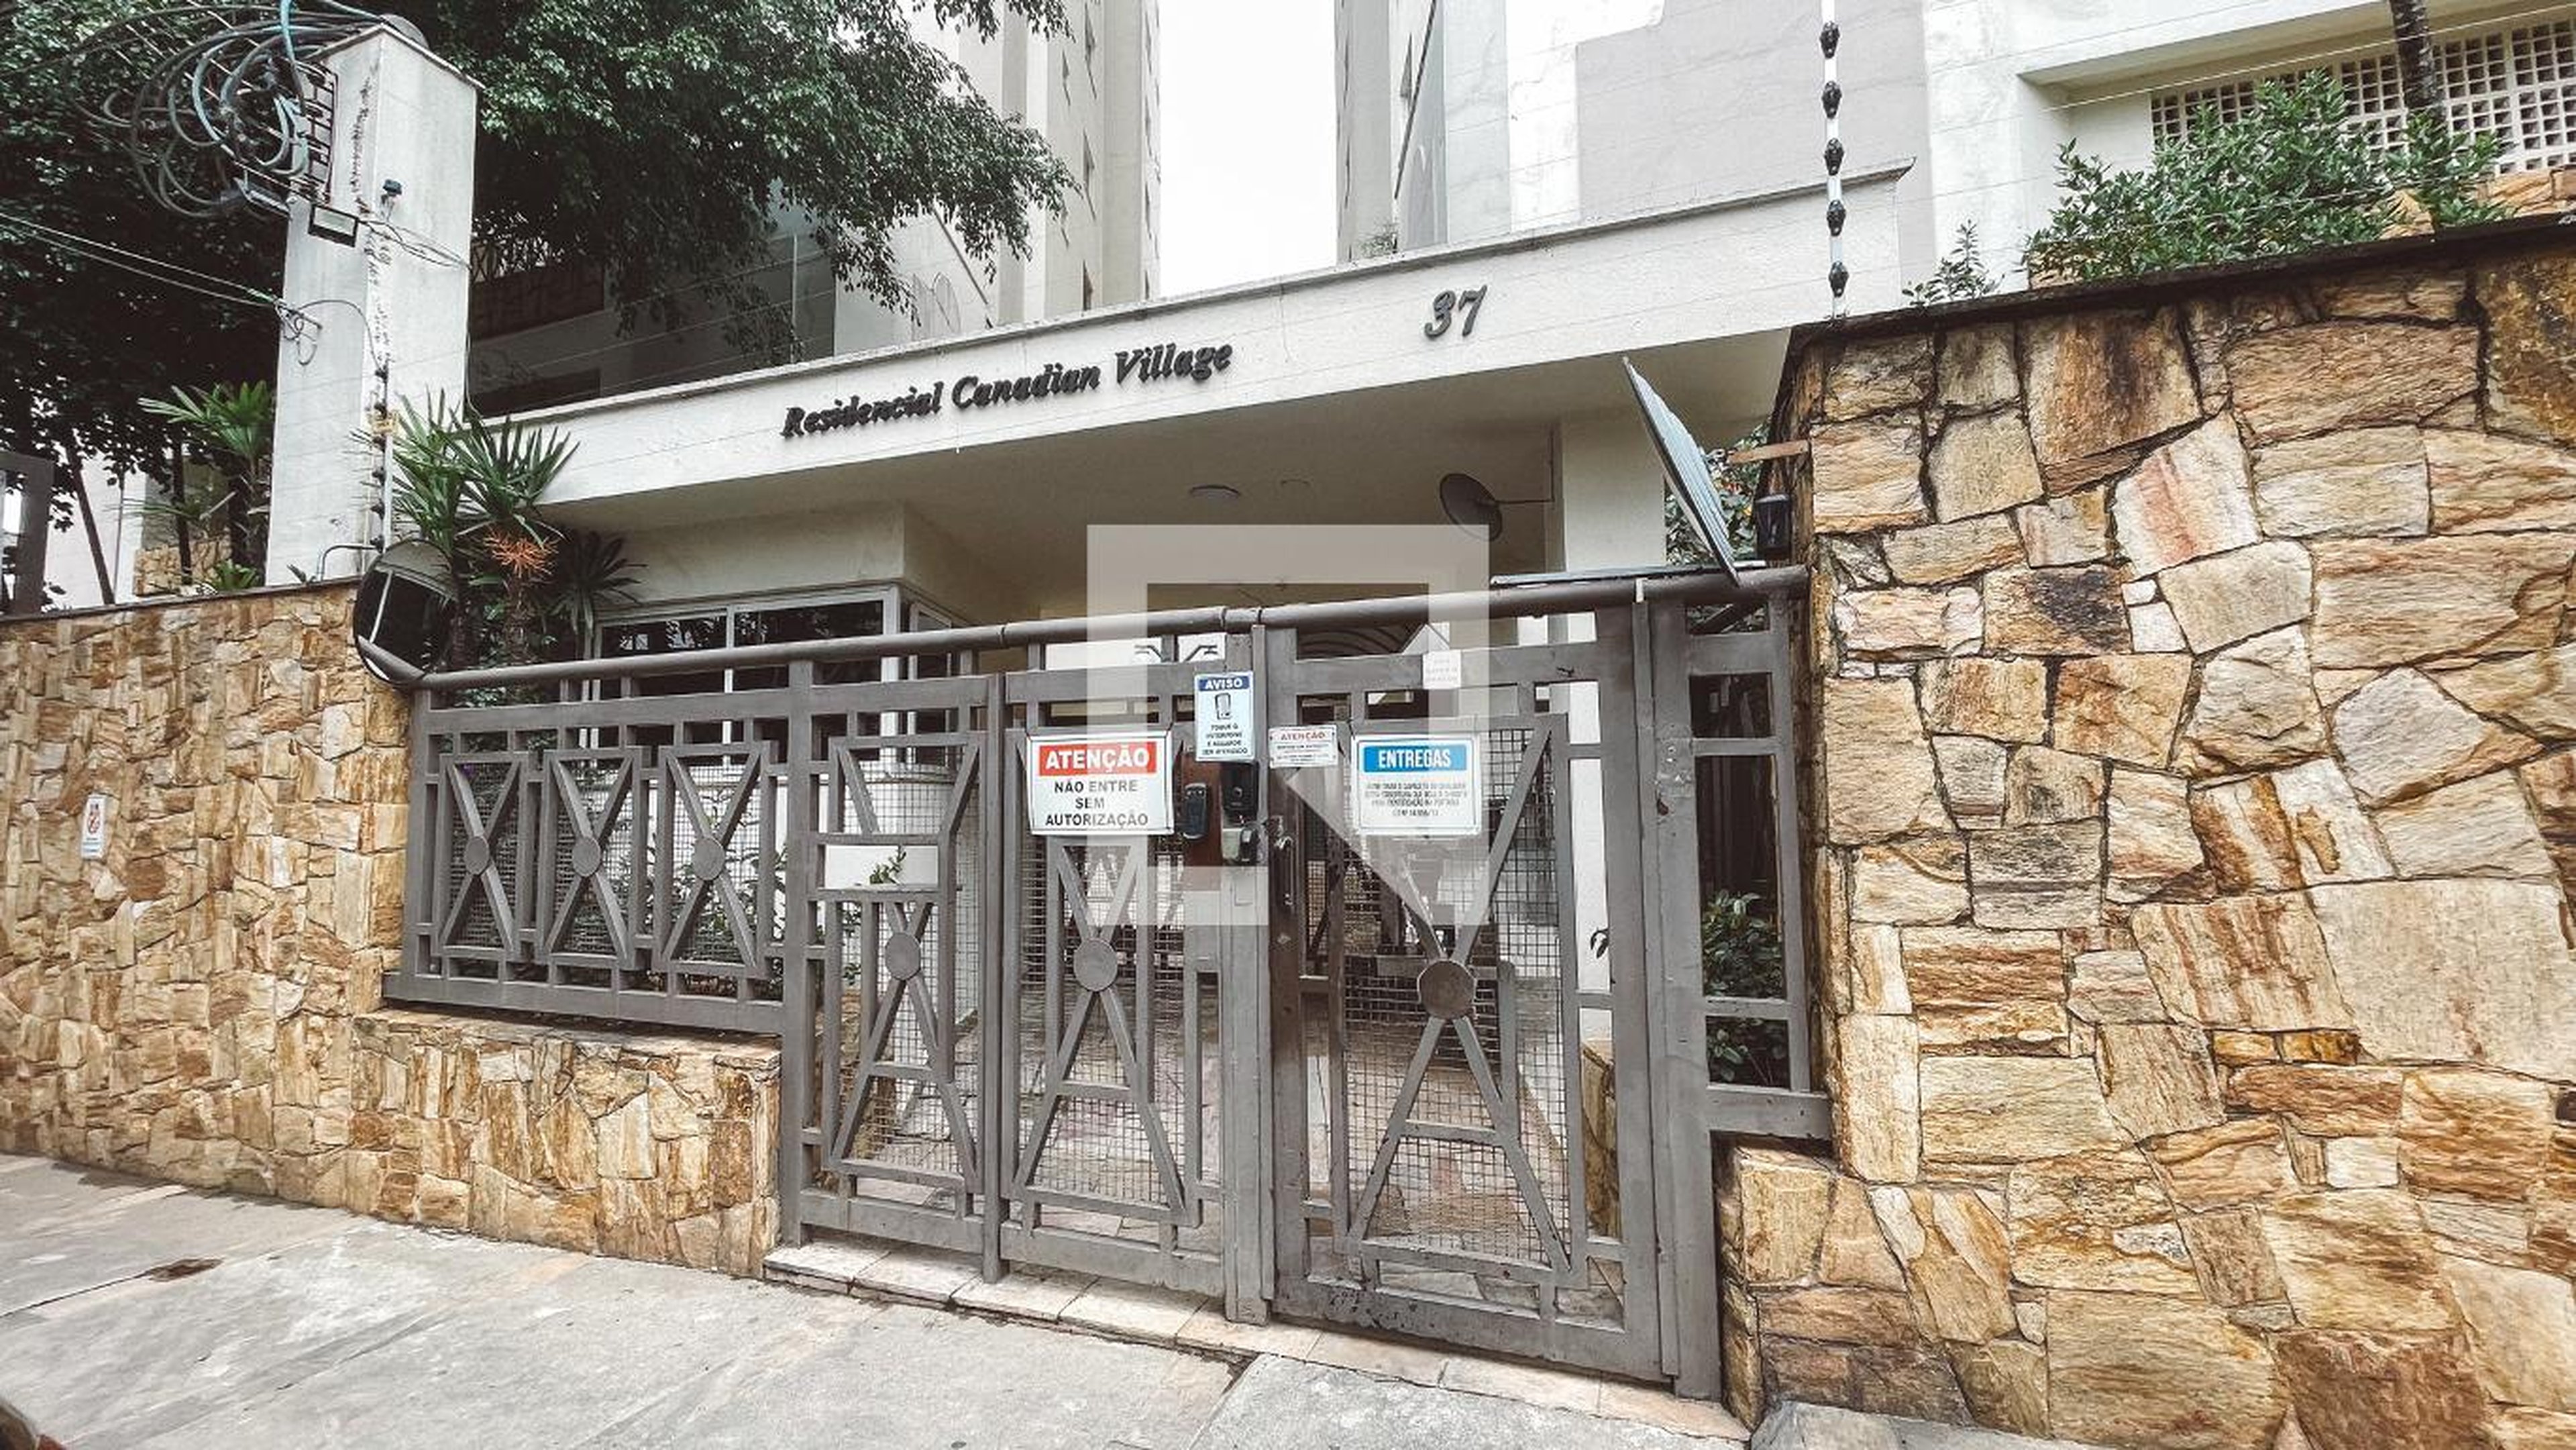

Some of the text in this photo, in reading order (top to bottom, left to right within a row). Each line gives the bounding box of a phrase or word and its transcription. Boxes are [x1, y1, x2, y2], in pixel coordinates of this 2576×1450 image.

[1424, 284, 1487, 340] 37
[780, 342, 1232, 437] Residencial Canadian Village
[1205, 677, 1242, 690] AVISO
[1045, 744, 1150, 773] ATENÇÃO
[1378, 749, 1452, 768] ENTREGAS
[1055, 778, 1138, 793] NÃO ENTRE
[1075, 797, 1105, 809] SEM
[1045, 810, 1148, 829] AUTORIZAÇÃO
